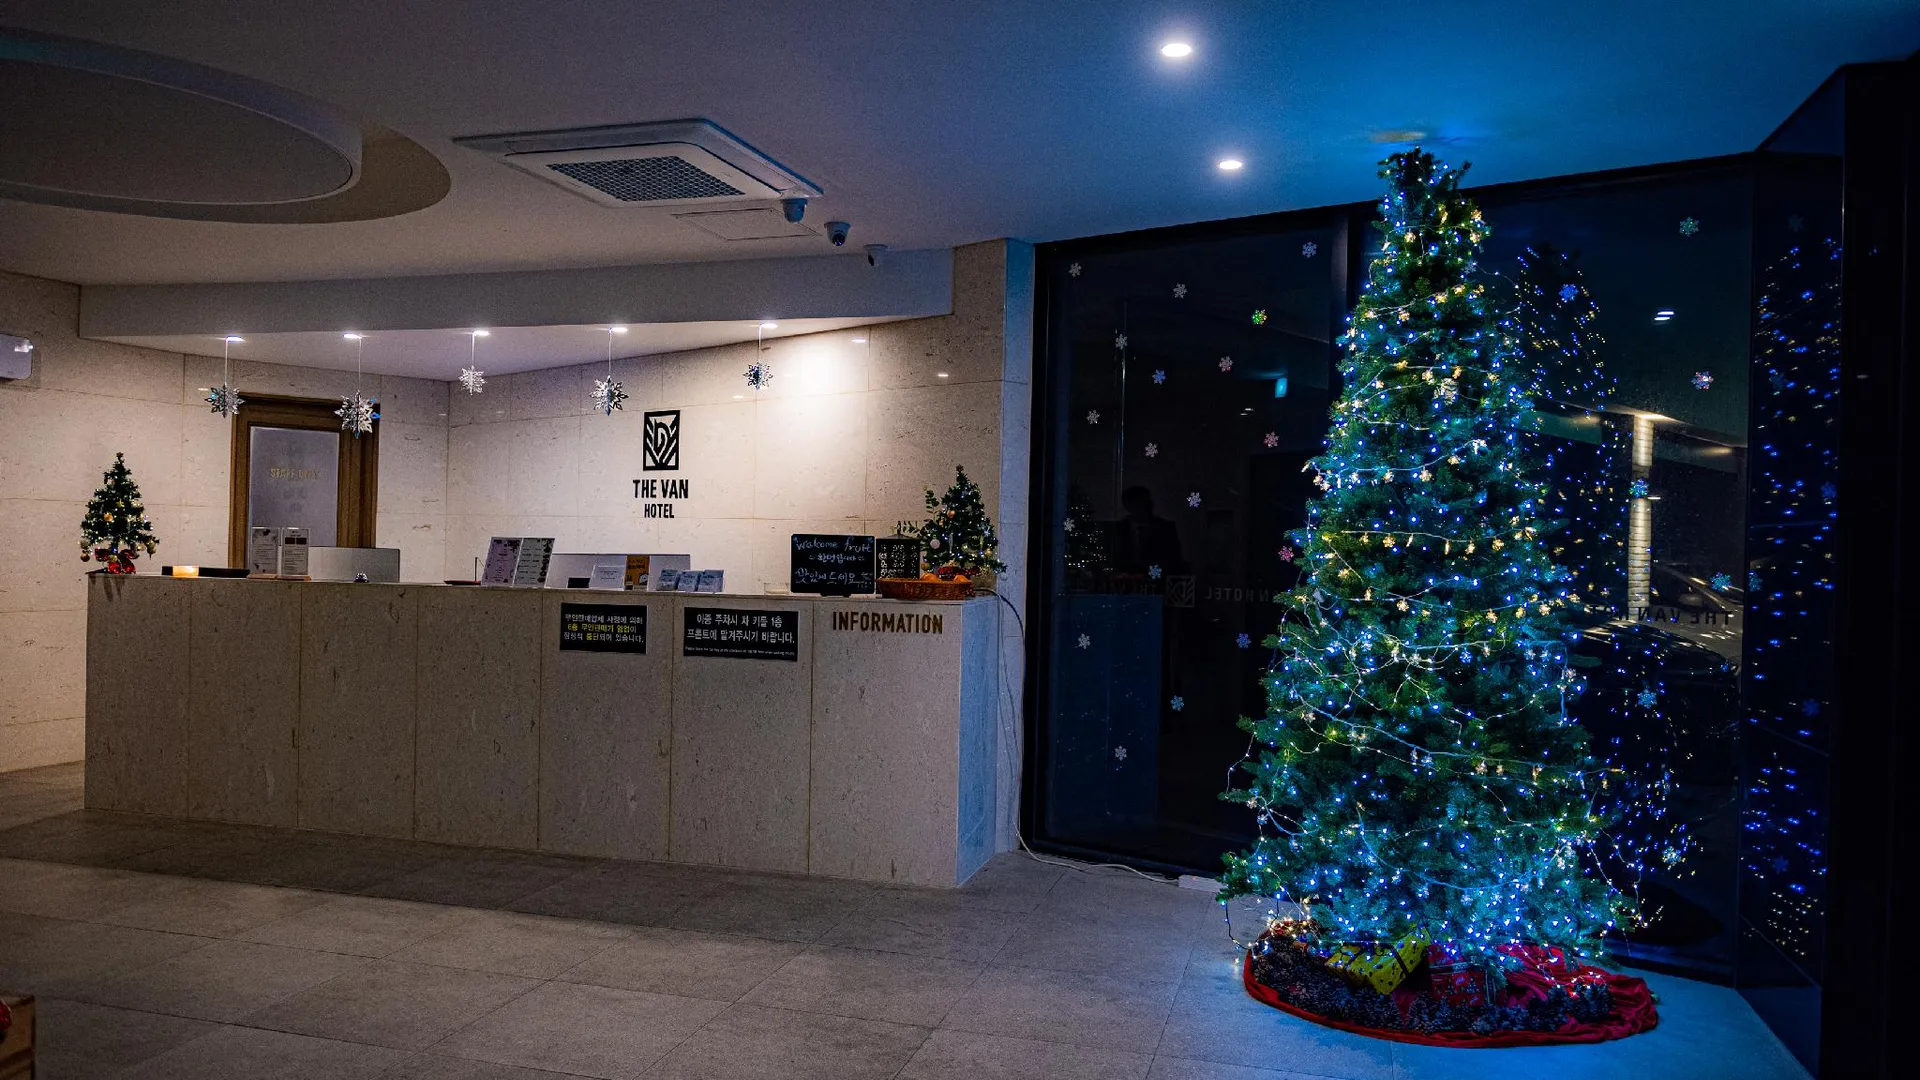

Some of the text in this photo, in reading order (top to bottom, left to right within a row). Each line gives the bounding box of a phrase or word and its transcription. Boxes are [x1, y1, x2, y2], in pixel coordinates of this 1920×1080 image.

[632, 479, 688, 499] THE VAN
[644, 503, 674, 518] HOTEL
[696, 613, 782, 628] 이중 주차시 차 키를 1층
[832, 611, 943, 634] INFORMATION
[687, 628, 795, 644] 프론트에 맡겨주시기 바랍니다.
